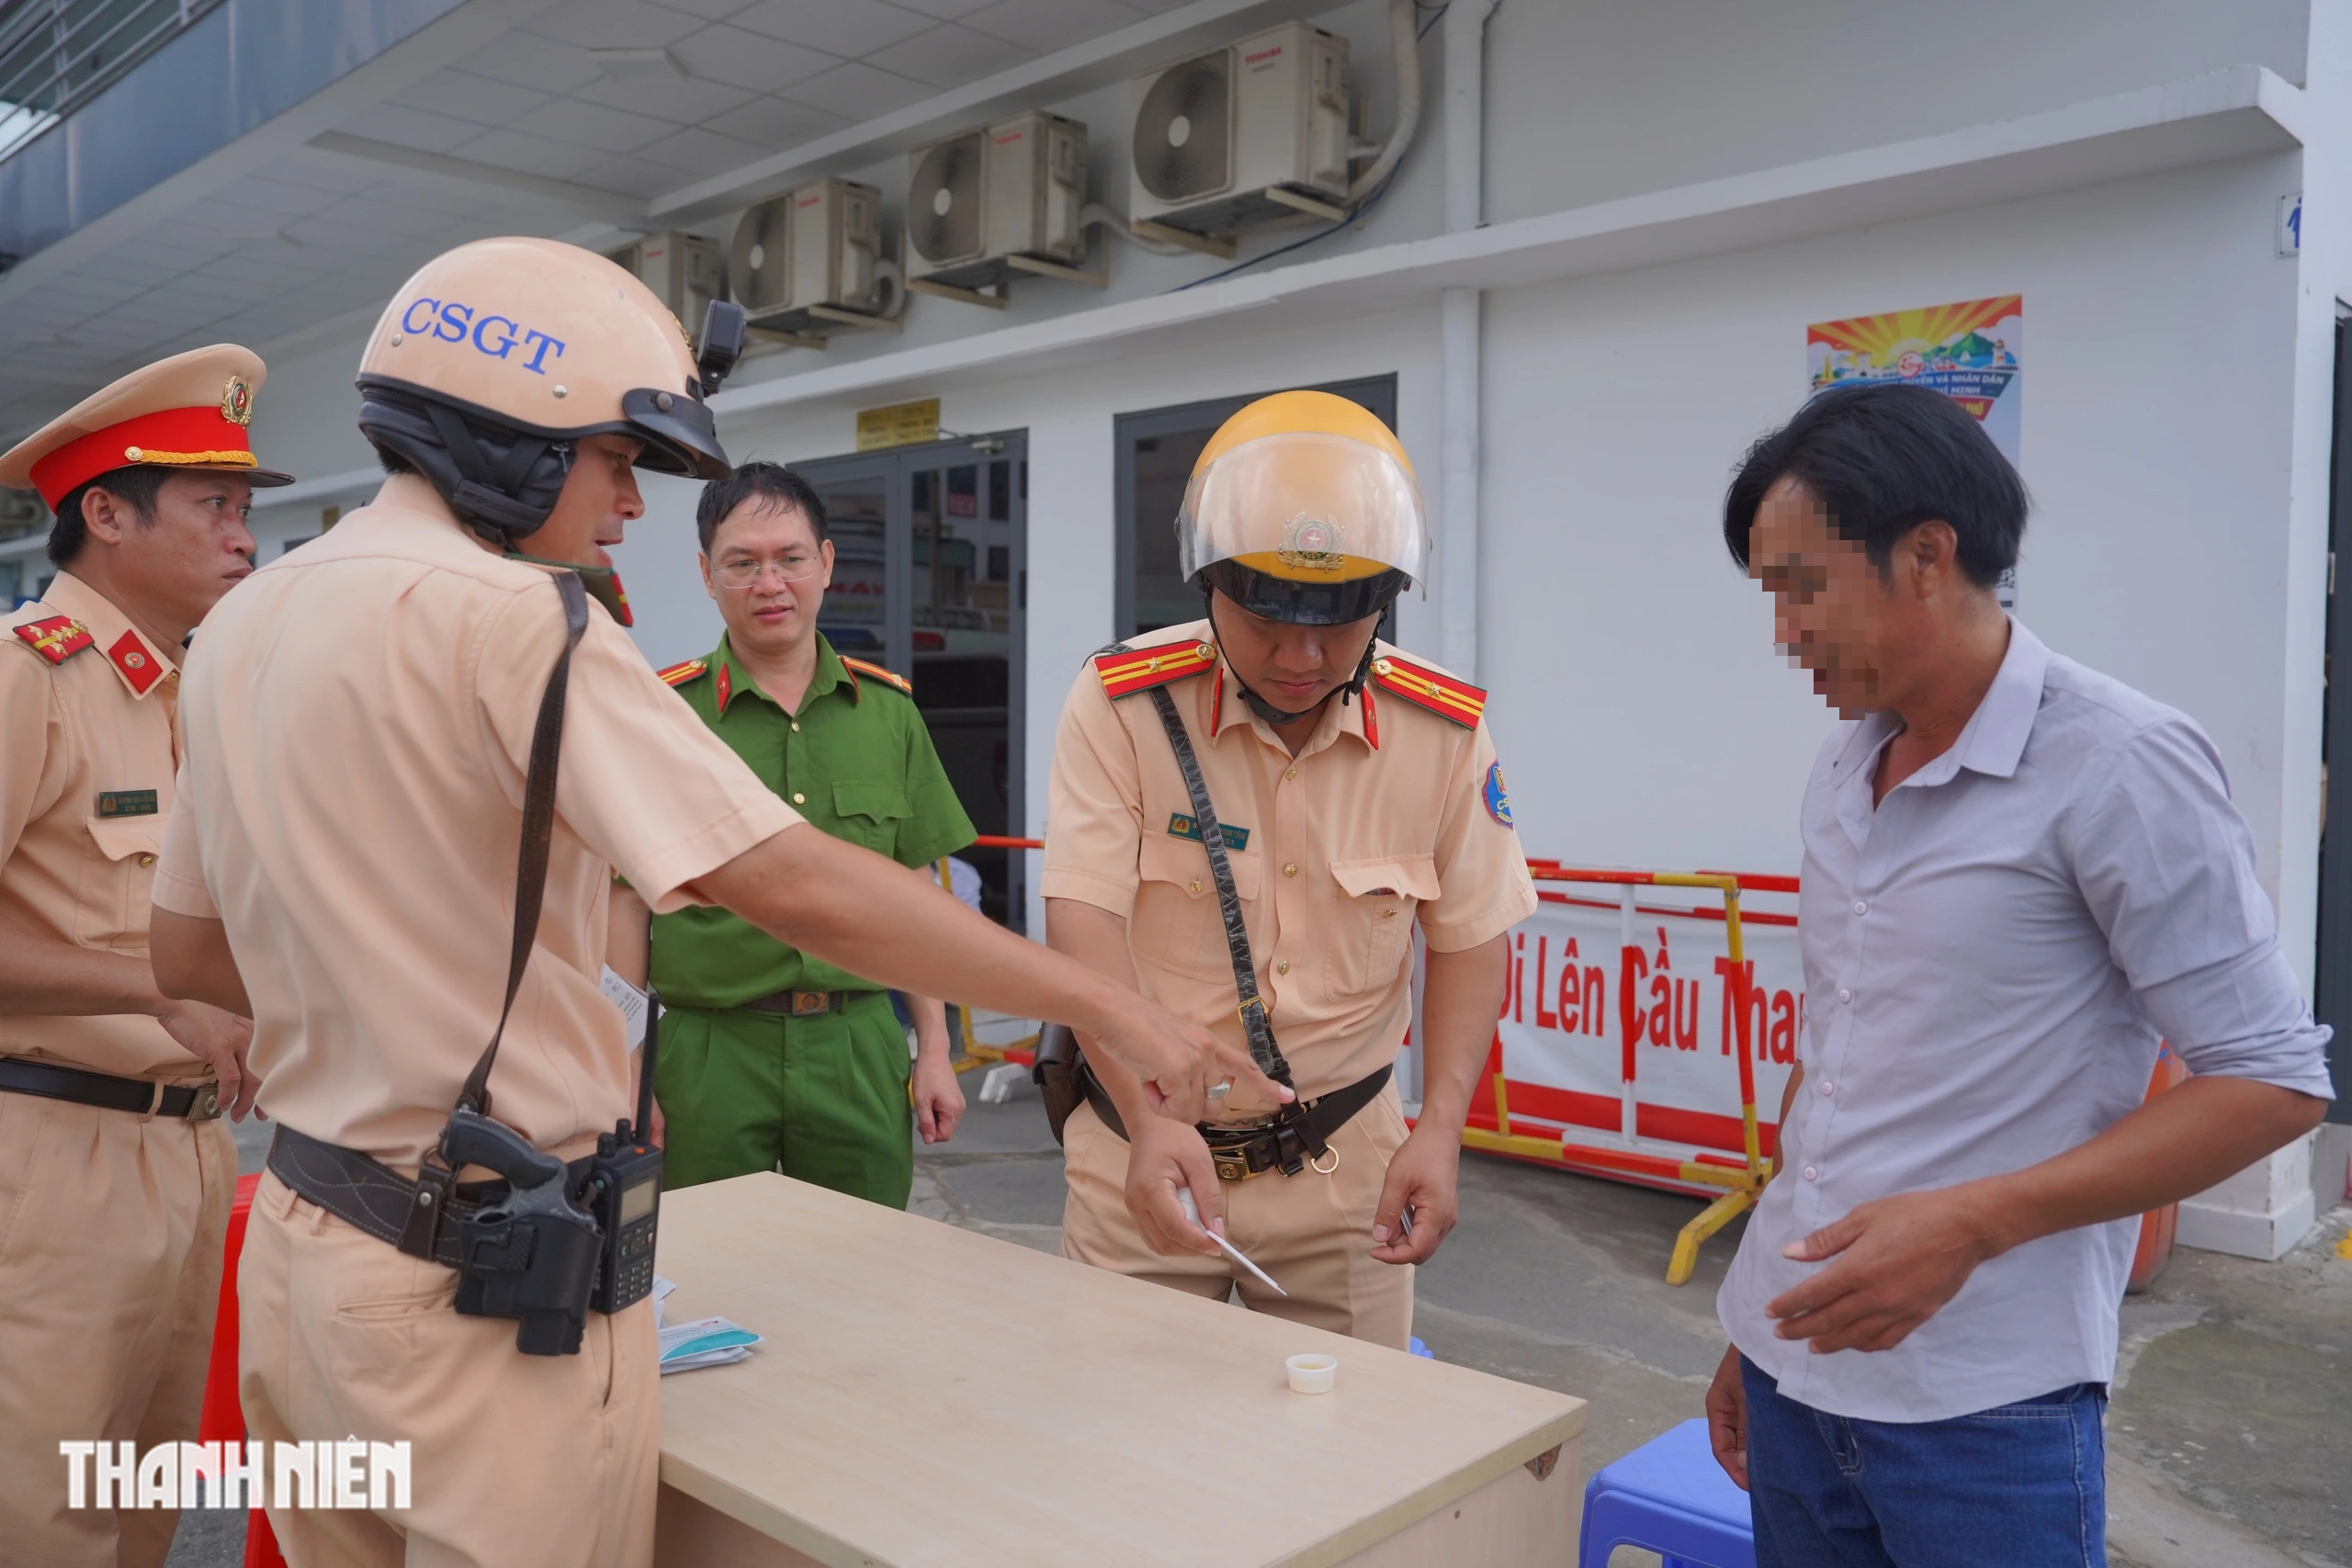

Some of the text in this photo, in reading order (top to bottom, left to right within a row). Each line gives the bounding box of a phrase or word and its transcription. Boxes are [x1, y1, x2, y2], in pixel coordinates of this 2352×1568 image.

[401, 298, 566, 376] CSGT
[1536, 935, 1604, 1038] Lên
[1619, 926, 1700, 1052] Cầu
[1713, 956, 1806, 1066] Tha
